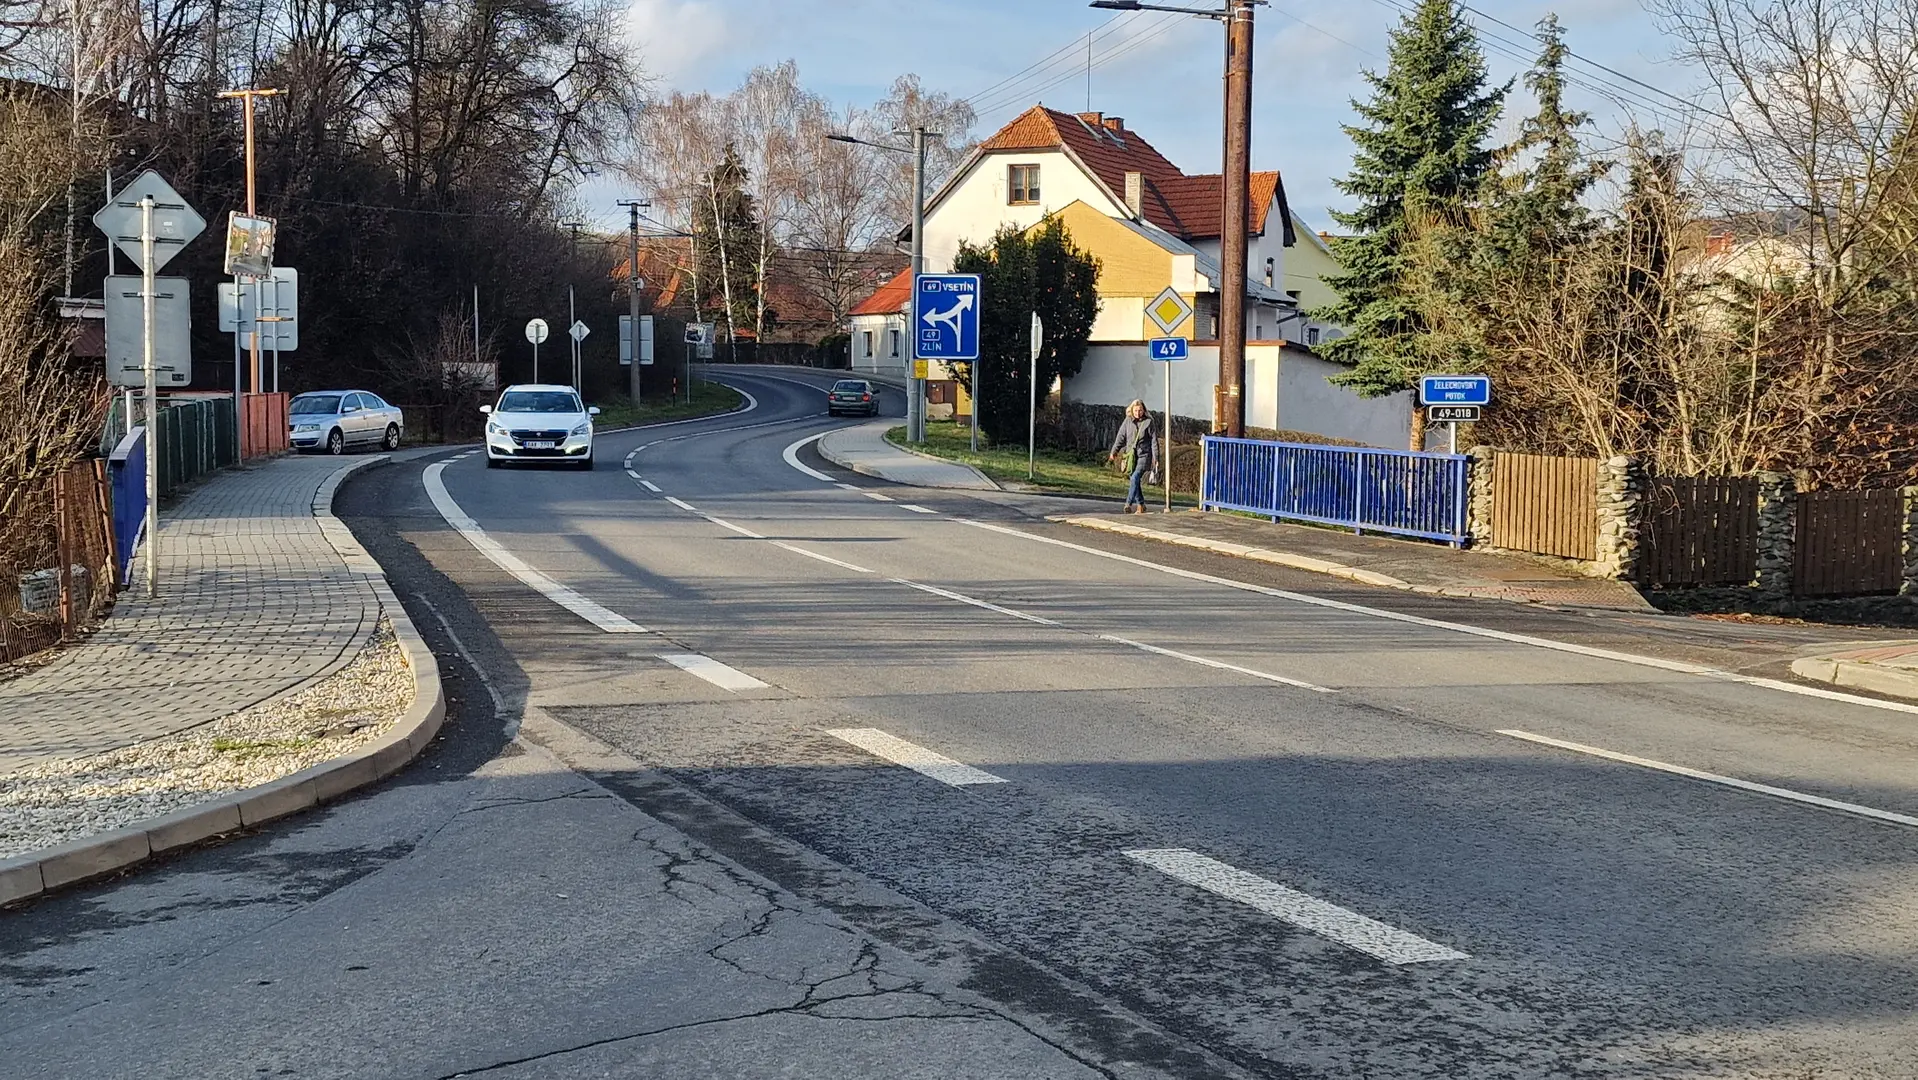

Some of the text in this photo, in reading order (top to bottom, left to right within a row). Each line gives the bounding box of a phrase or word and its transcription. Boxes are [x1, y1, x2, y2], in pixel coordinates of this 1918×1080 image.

[927, 281, 974, 292] 69 VSETÍN
[926, 331, 936, 339] 49
[921, 341, 942, 351] ZLÍN
[1159, 342, 1177, 355] 49
[1444, 392, 1467, 400] POTOK
[1438, 408, 1472, 418] 49-018
